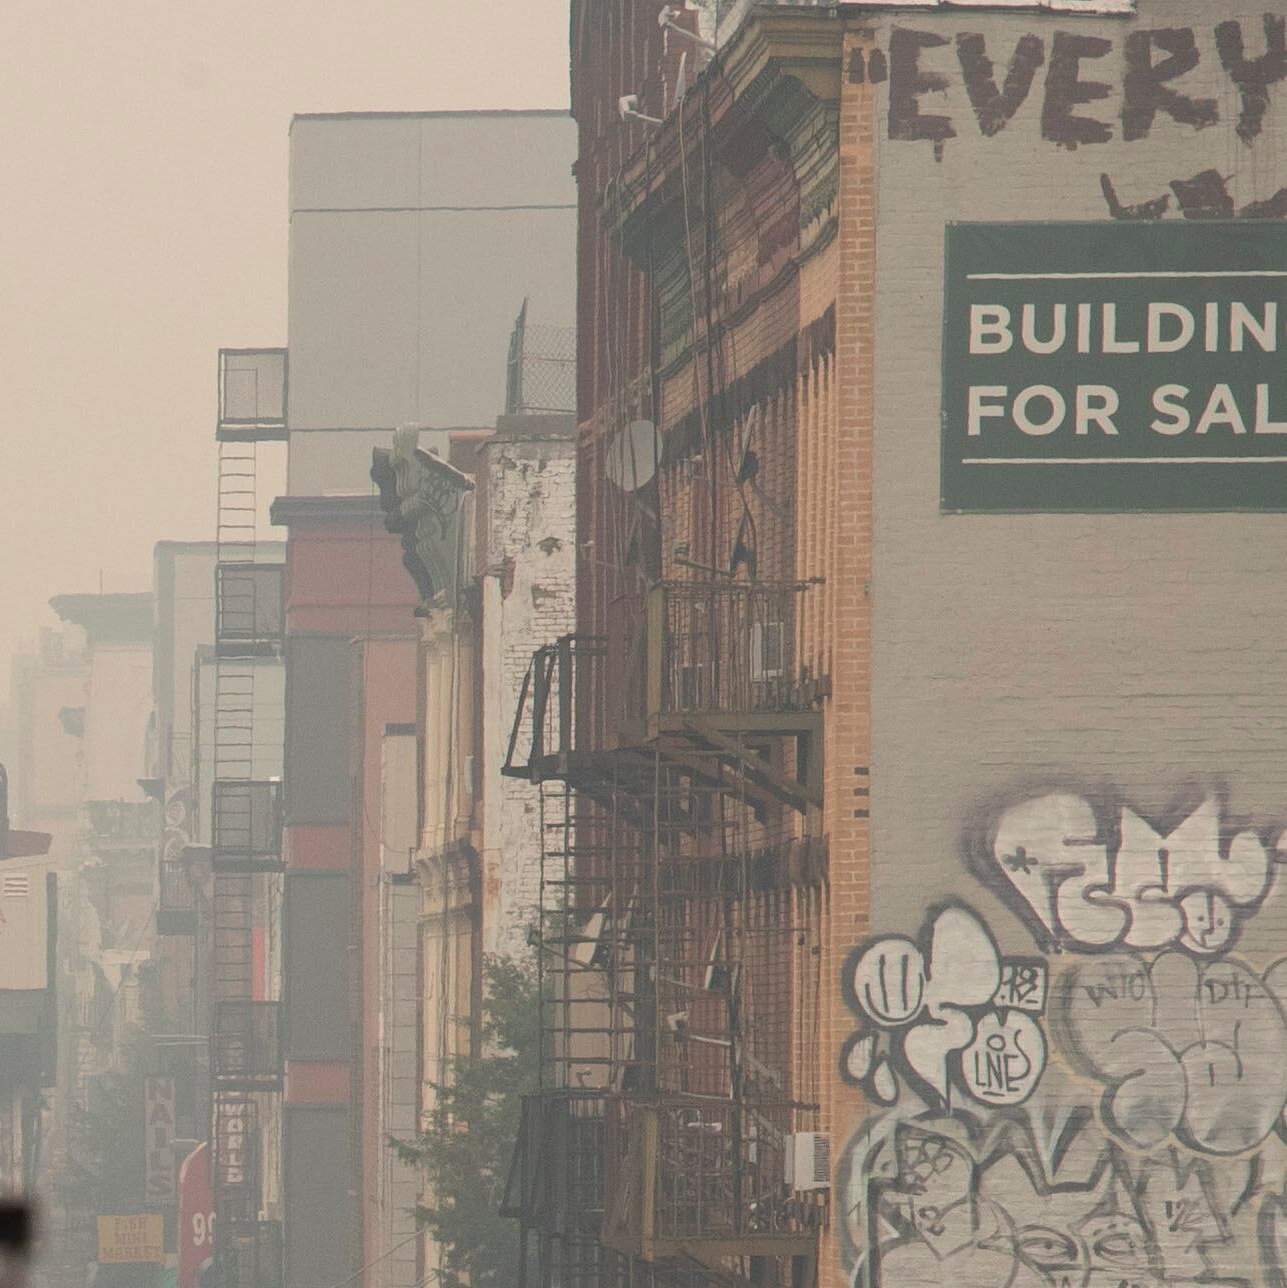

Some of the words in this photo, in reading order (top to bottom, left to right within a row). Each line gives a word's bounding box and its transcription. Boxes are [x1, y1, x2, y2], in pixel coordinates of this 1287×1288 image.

[969, 302, 1287, 355] BUILDIN
[967, 384, 1119, 436] FOR
[145, 1078, 173, 1198] NAILS
